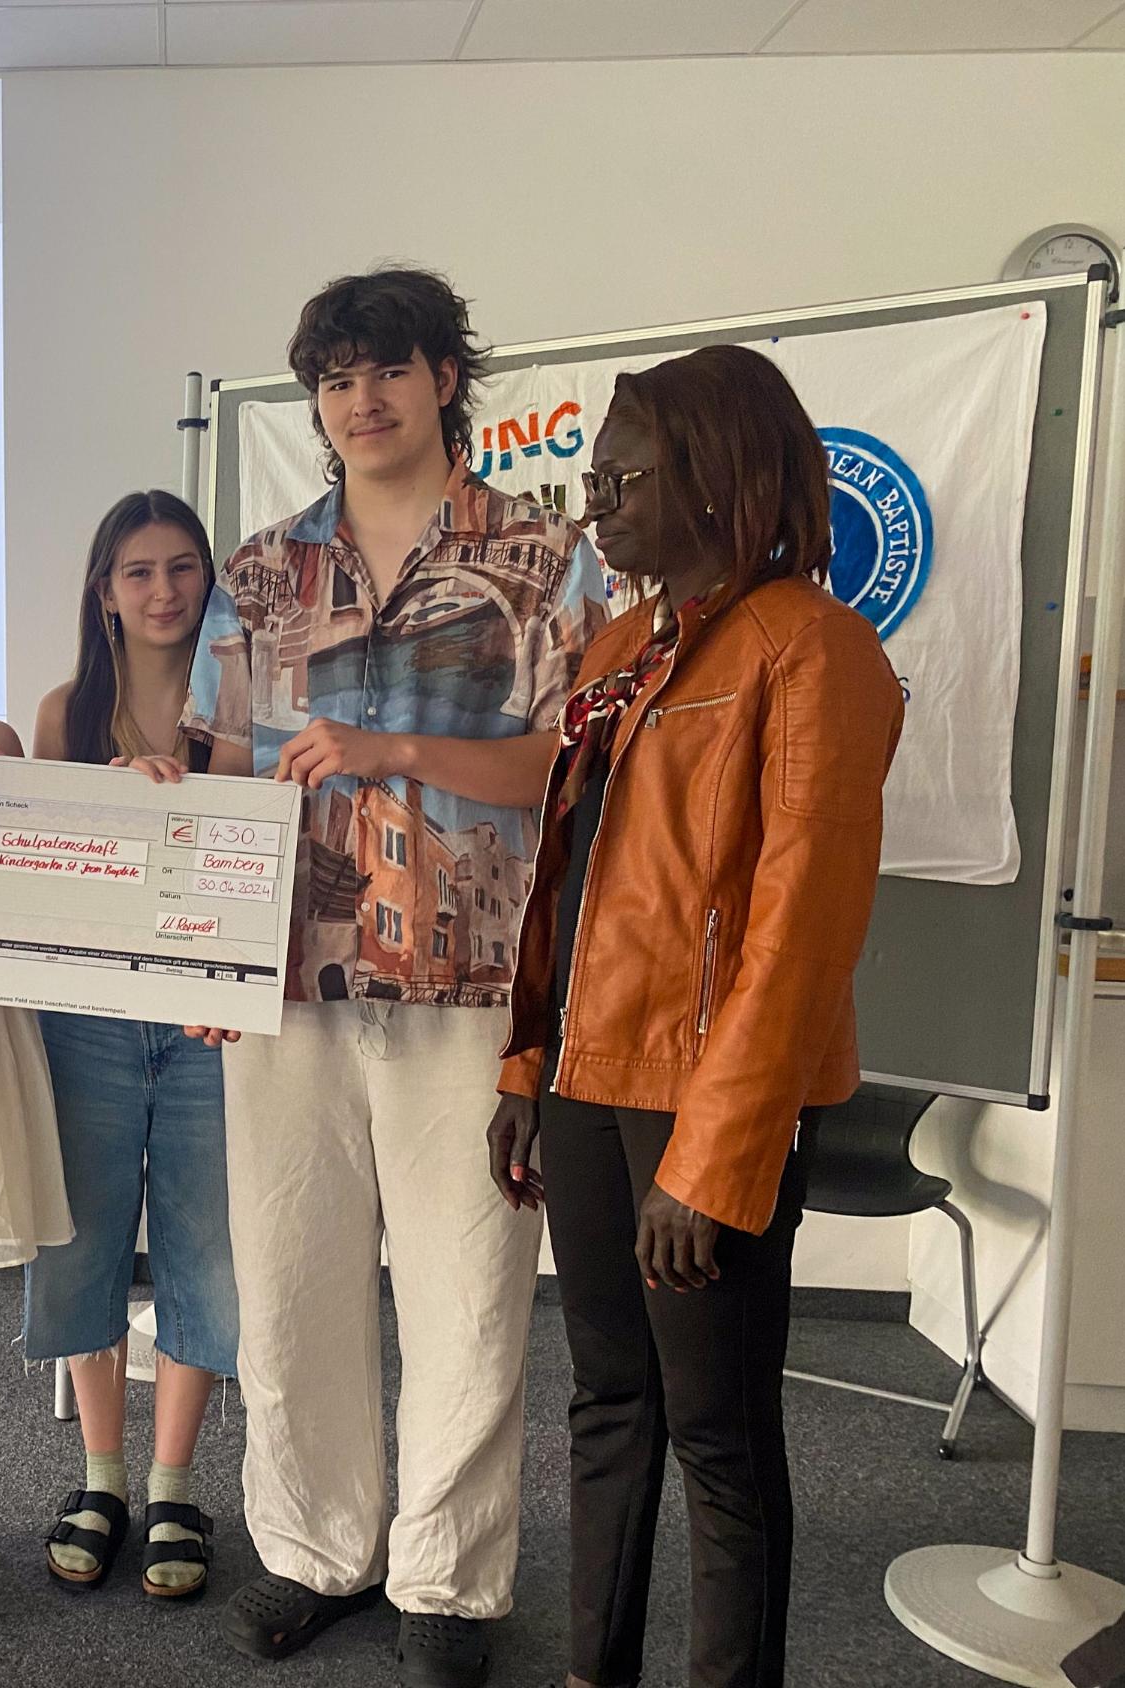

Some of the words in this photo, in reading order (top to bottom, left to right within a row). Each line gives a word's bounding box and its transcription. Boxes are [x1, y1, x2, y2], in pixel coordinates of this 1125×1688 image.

[5, 801, 29, 809] Scheck
[1, 832, 118, 857] Schulpatenschaft
[202, 853, 265, 875] Bamberg
[161, 867, 173, 875] Ort
[159, 891, 182, 900] Datum
[155, 931, 194, 942] Unterschrift
[78, 1003, 91, 1011] und
